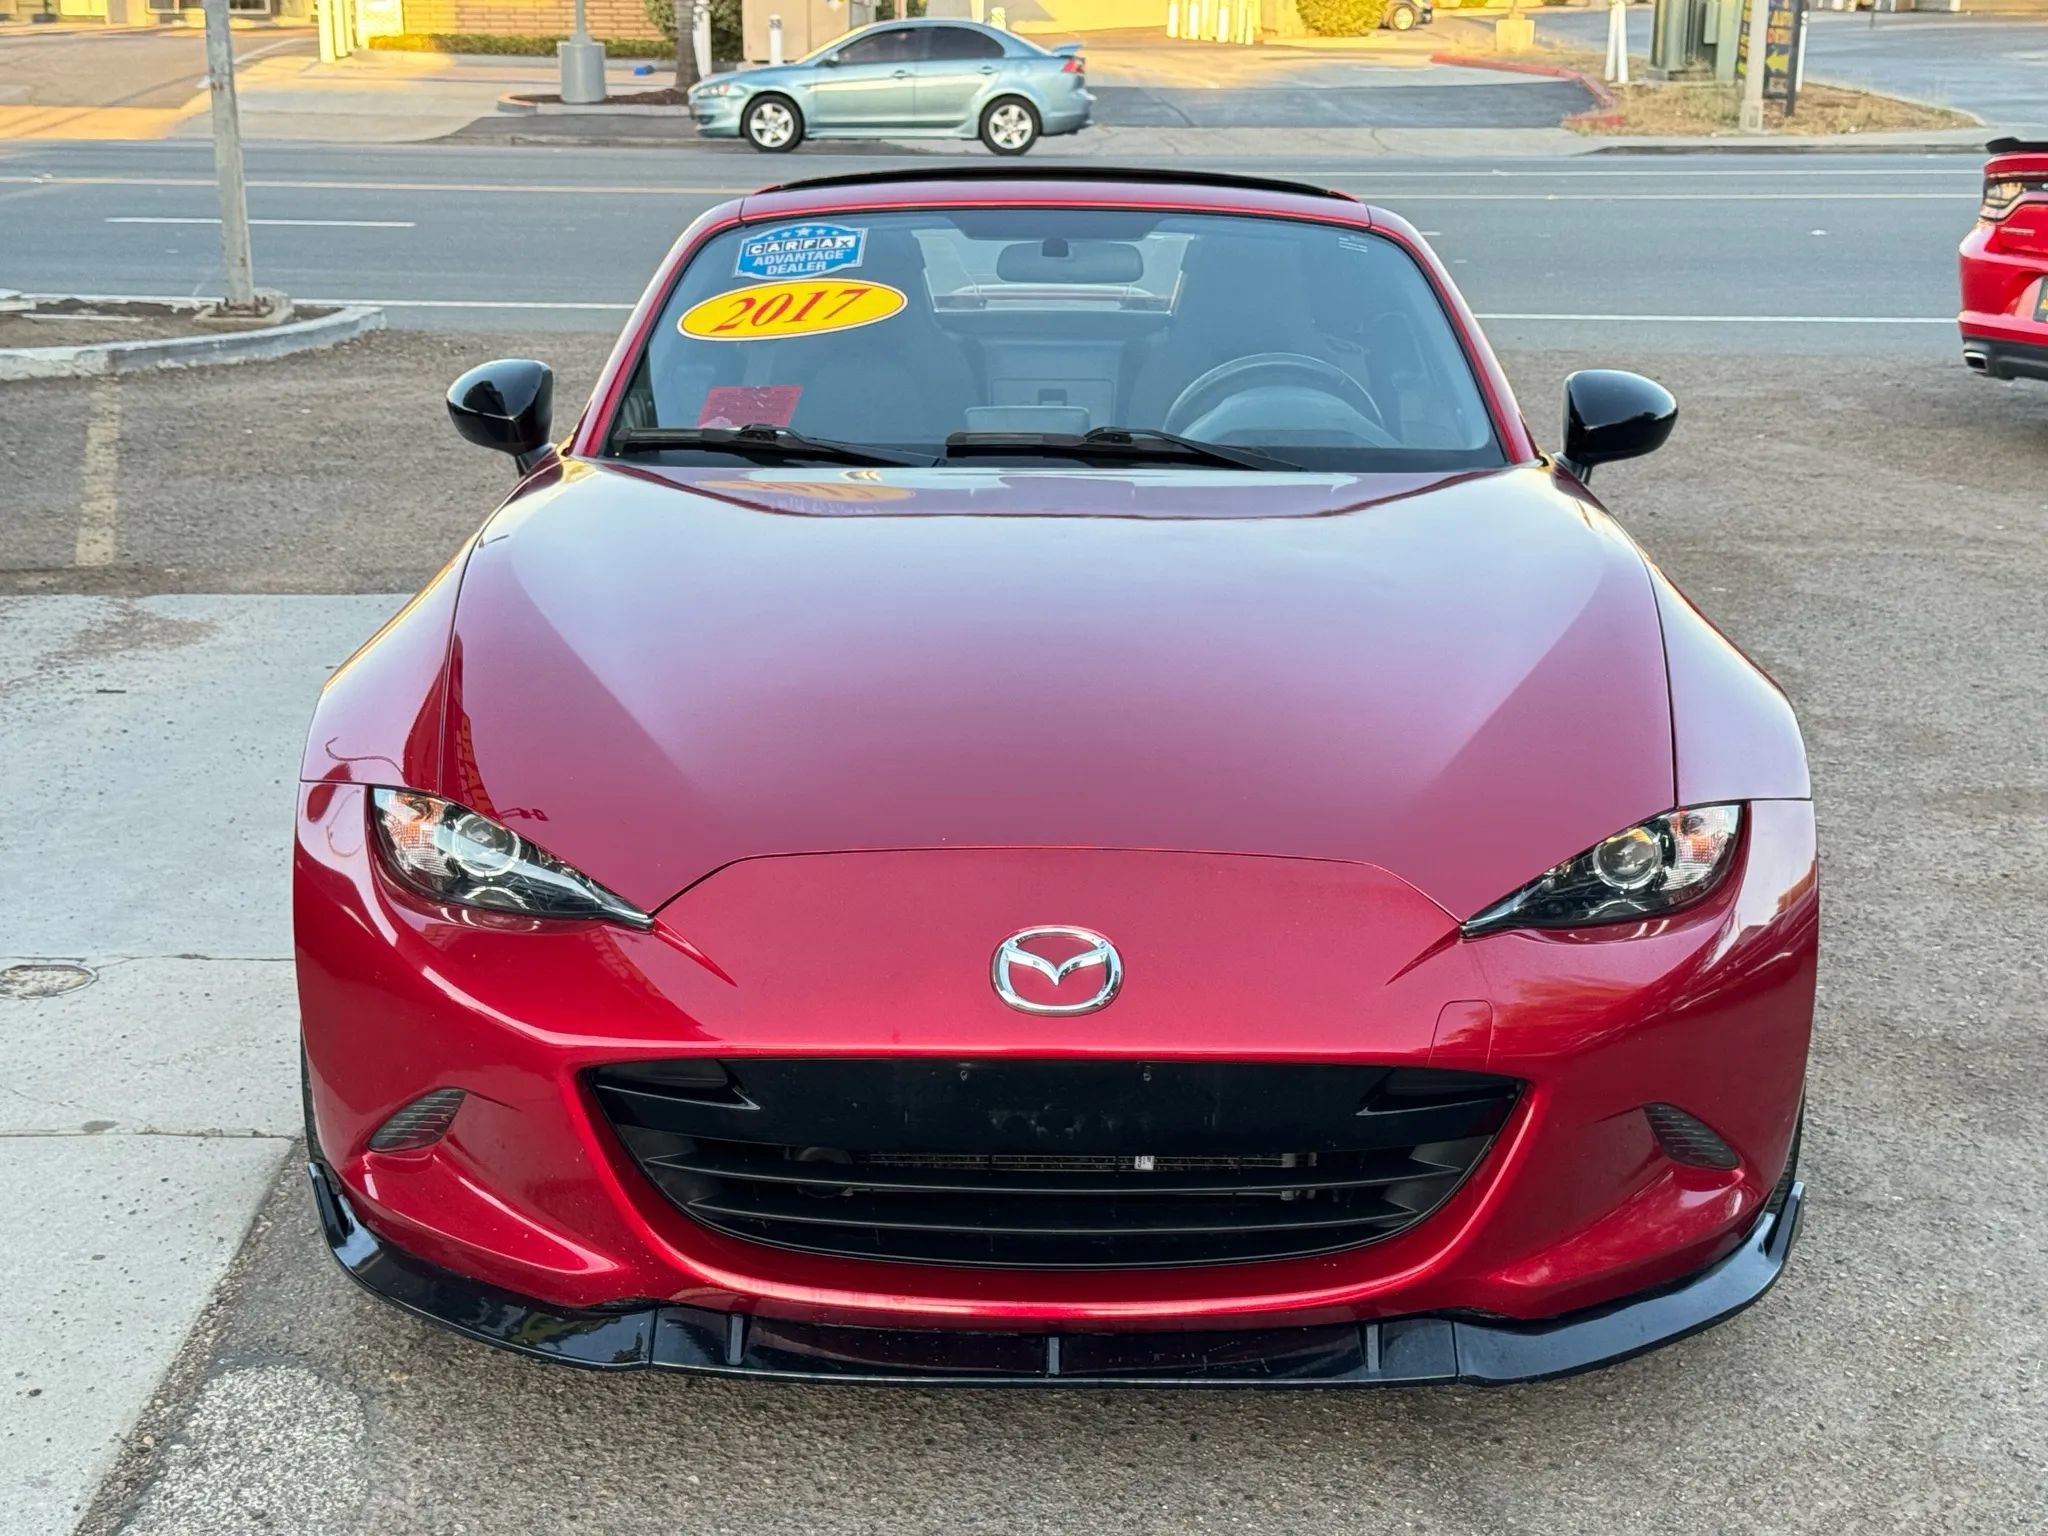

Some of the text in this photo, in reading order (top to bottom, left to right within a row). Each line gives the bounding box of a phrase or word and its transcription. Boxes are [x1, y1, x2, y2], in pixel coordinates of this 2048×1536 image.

[750, 238, 853, 254] CARFAX
[752, 249, 845, 267] ADVANTAGE
[766, 260, 828, 275] DEALER
[710, 288, 871, 332] 2017
